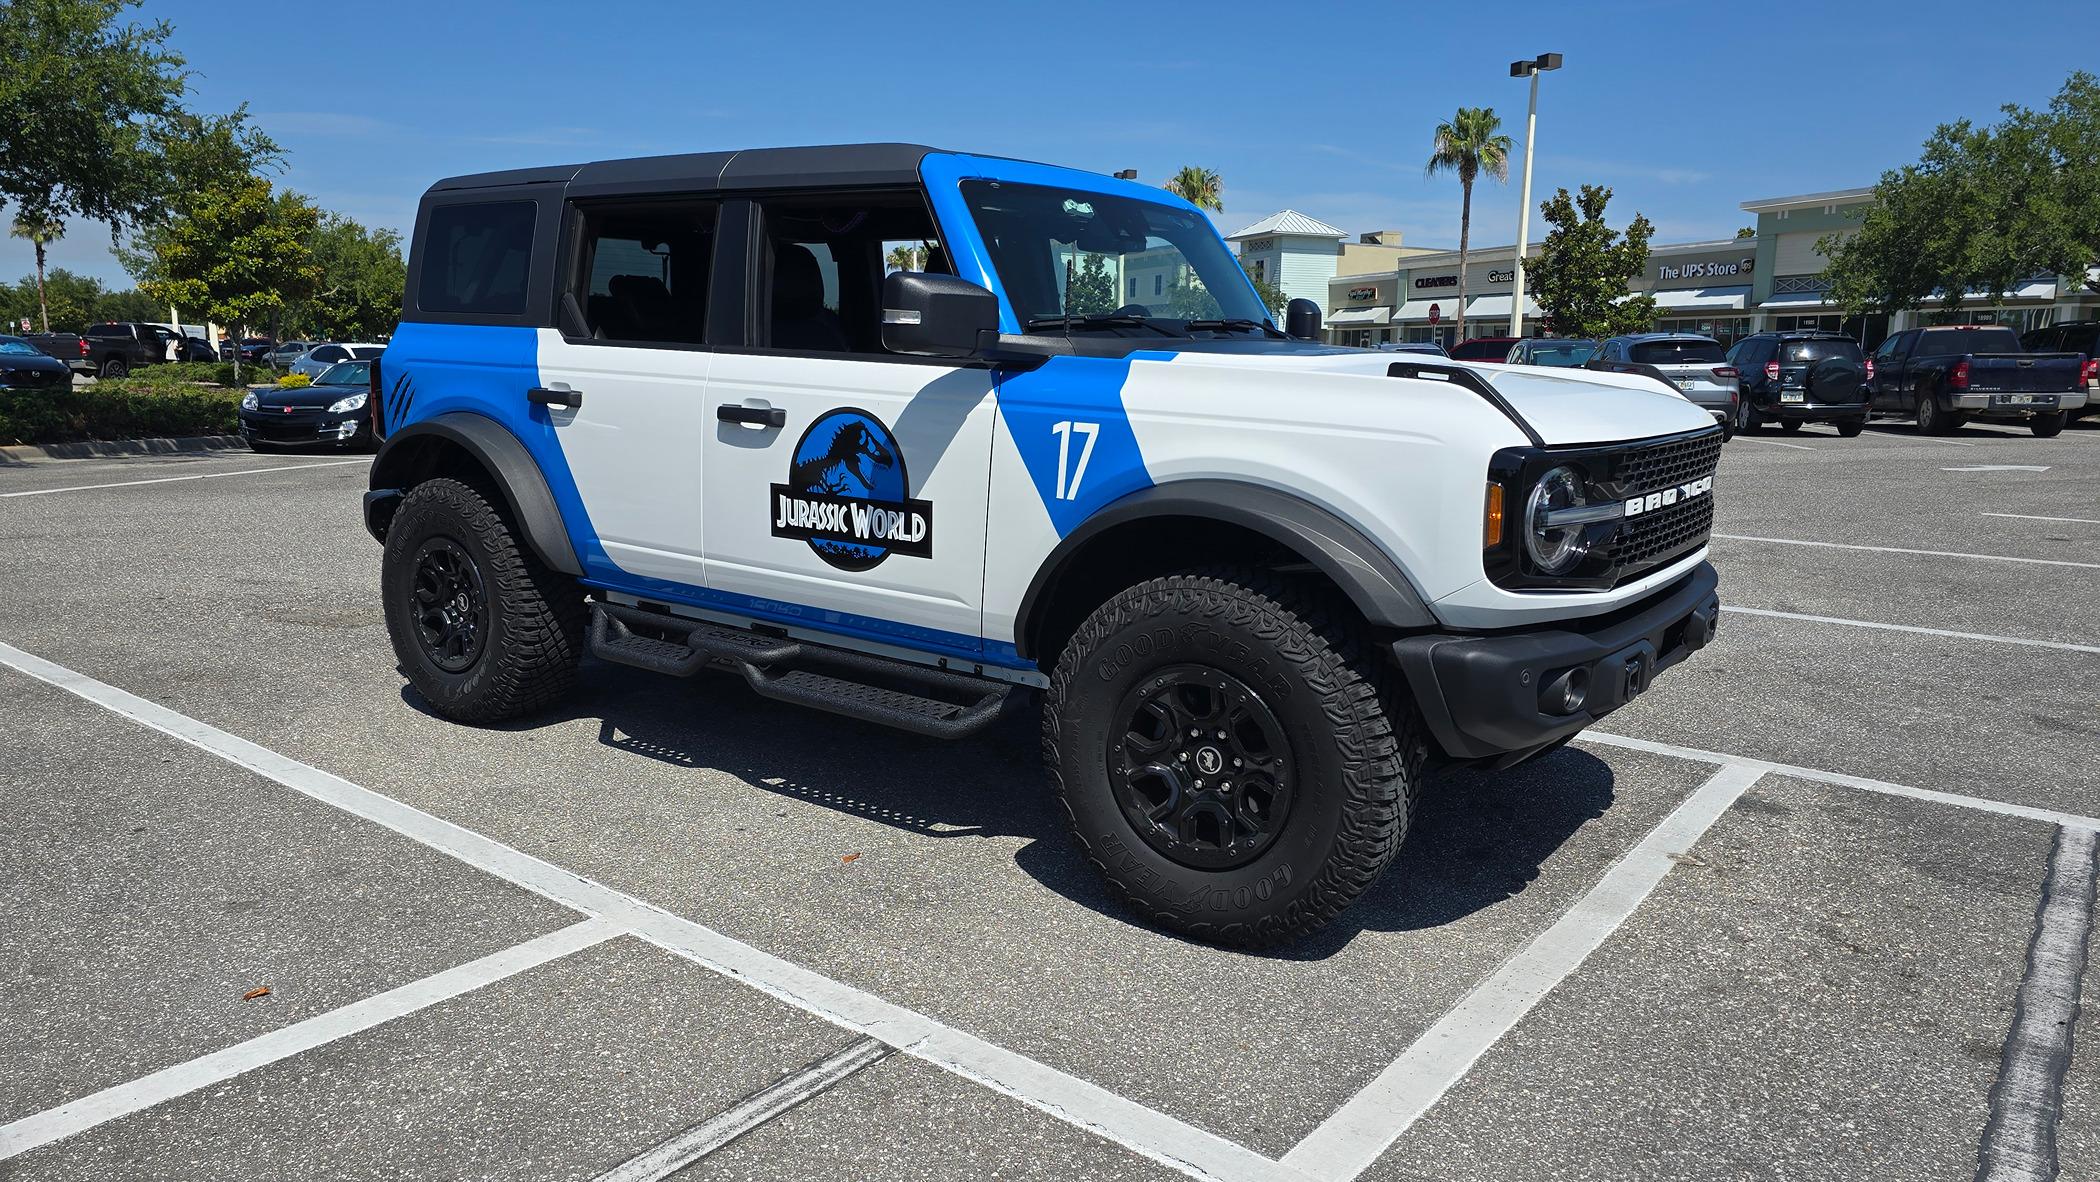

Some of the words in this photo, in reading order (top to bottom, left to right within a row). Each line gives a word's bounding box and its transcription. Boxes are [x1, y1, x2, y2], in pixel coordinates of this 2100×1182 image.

[1488, 270, 1513, 282] Great
[1659, 266, 1679, 280] The
[1681, 263, 1704, 278] UPS
[1707, 262, 1737, 277] Store
[1052, 420, 1100, 501] 17
[776, 494, 849, 533] JURASSIC
[850, 502, 927, 543] WORLD
